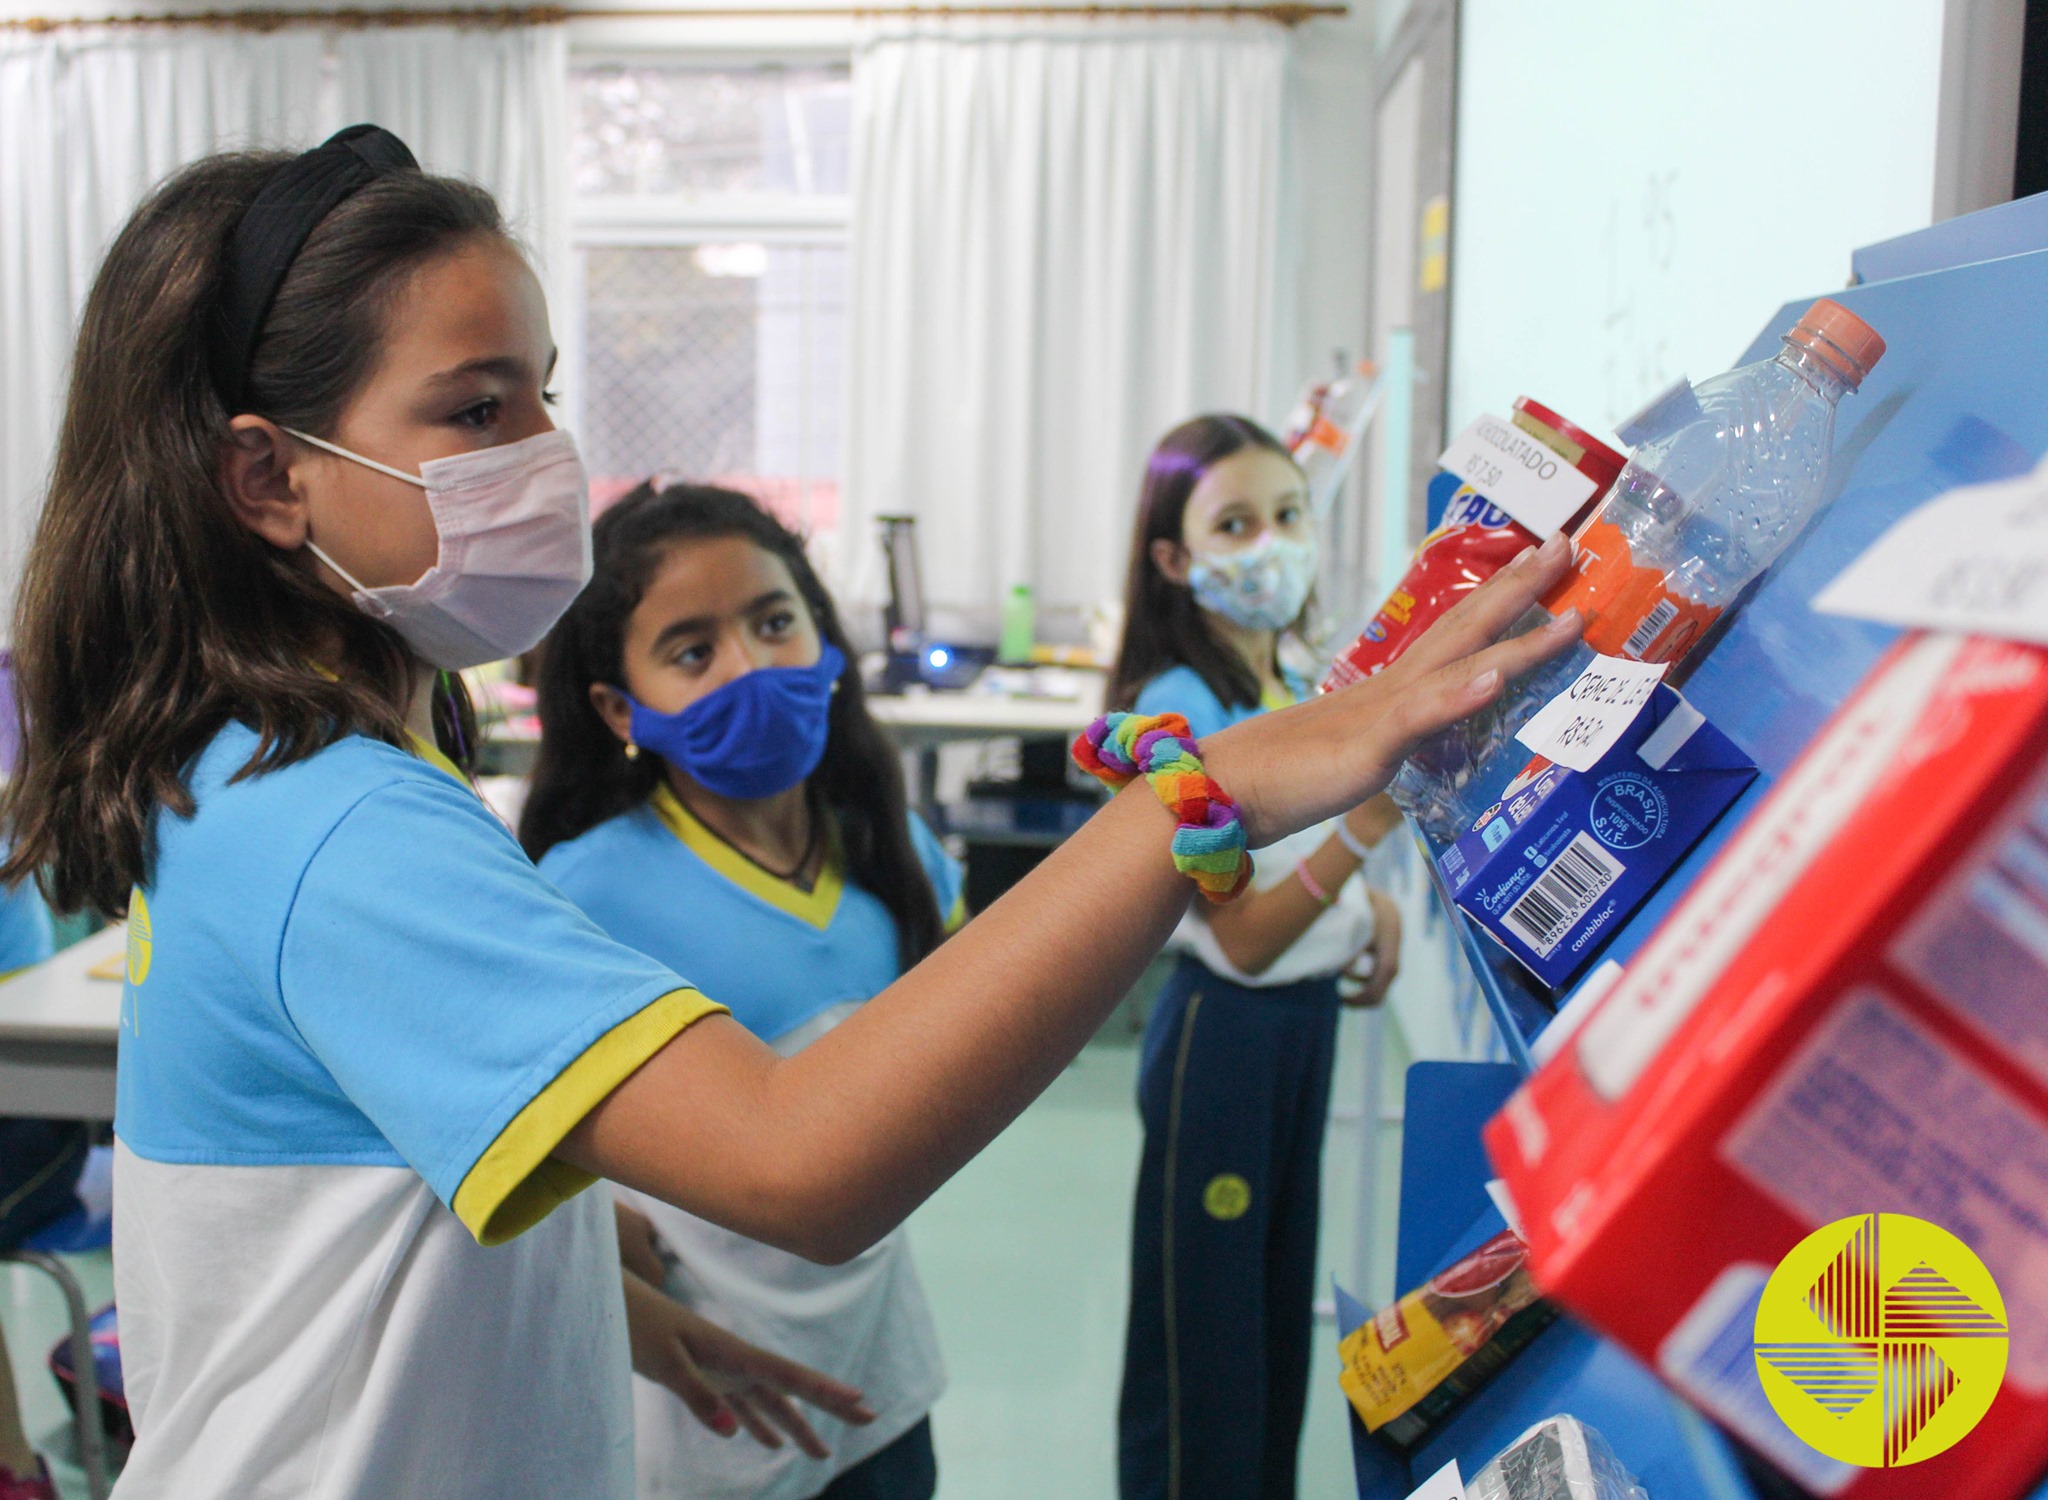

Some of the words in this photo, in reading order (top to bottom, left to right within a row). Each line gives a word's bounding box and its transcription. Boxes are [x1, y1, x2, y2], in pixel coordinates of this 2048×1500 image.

[1605, 795, 1649, 835] INSPECIONADO
[1608, 811, 1630, 832] 1056
[1614, 784, 1657, 823] BRASIL
[1652, 785, 1669, 839] AGRICULTURA
[1483, 866, 1526, 911] Confiança
[1534, 946, 1543, 956] 7
